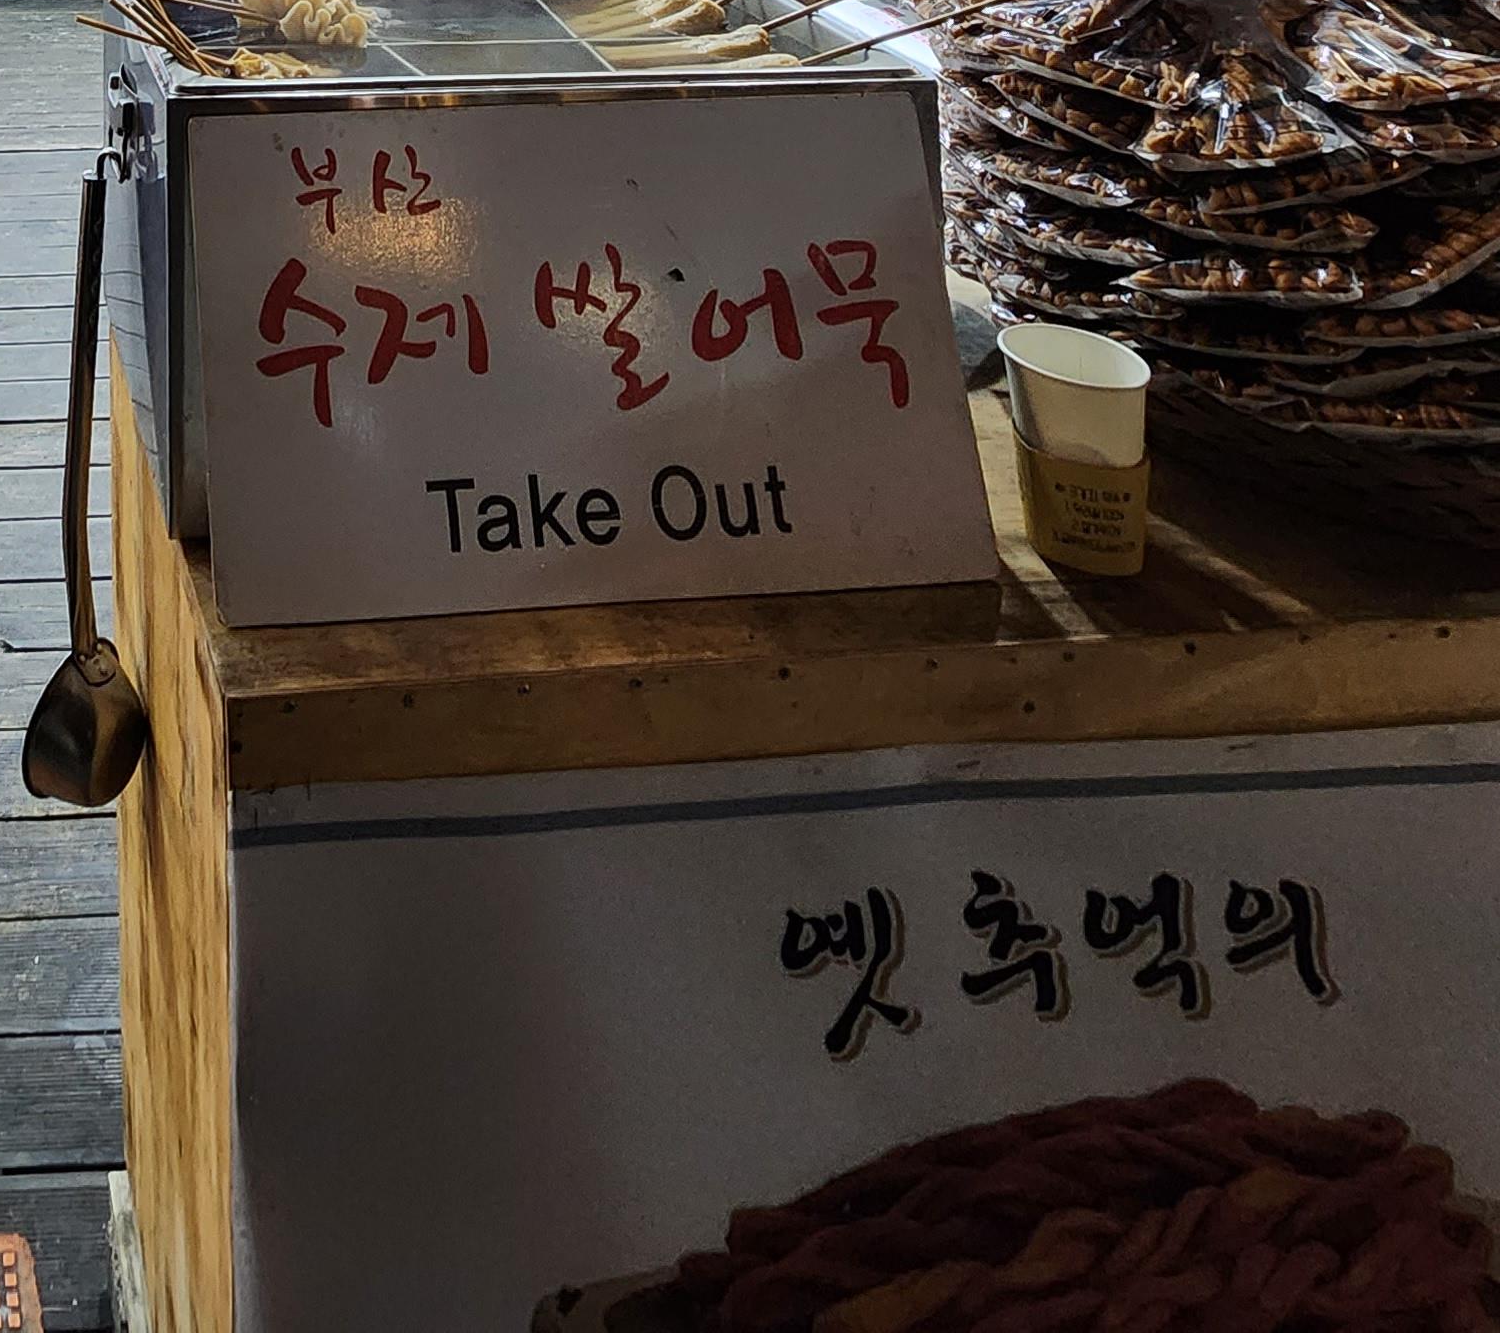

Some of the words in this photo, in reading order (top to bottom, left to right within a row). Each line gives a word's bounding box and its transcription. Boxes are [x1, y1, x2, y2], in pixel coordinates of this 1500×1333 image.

[289, 143, 444, 237] 부산
[253, 256, 492, 430] 수제
[425, 473, 622, 555] Take
[649, 463, 794, 539] Out
[781, 886, 920, 1061] 옛
[960, 869, 1340, 1023] 추억의
